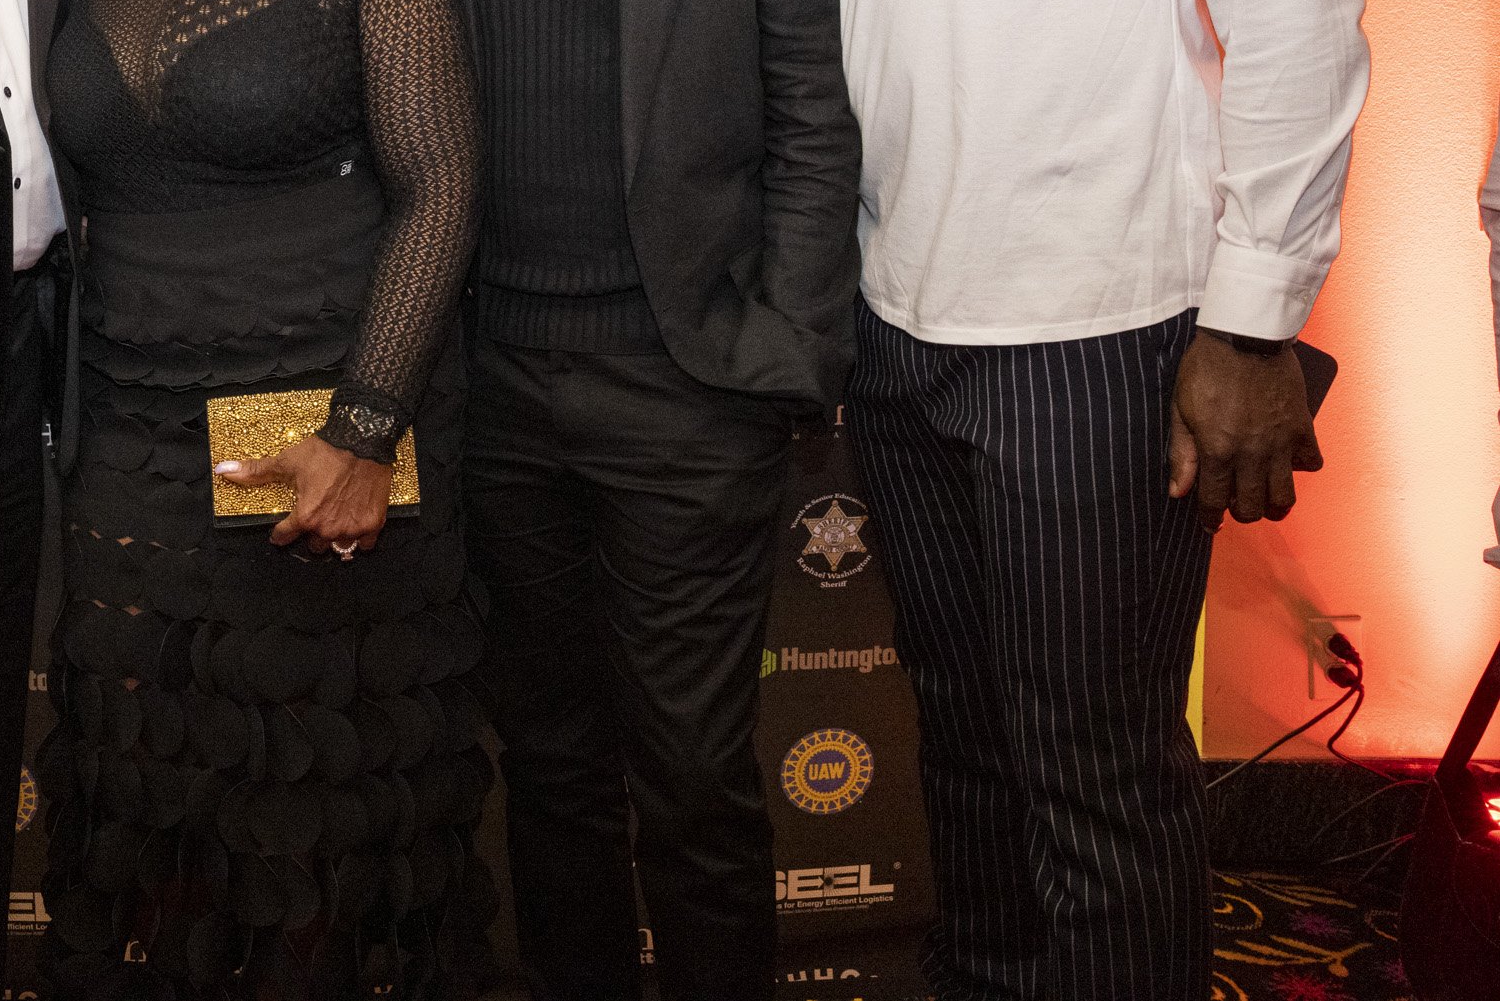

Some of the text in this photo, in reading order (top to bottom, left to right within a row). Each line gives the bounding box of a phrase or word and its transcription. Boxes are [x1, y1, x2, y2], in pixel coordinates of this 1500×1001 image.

[781, 645, 901, 679] Huntingto
[809, 761, 845, 781] UAW
[825, 898, 857, 906] Efficient
[859, 895, 894, 904] Logistics
